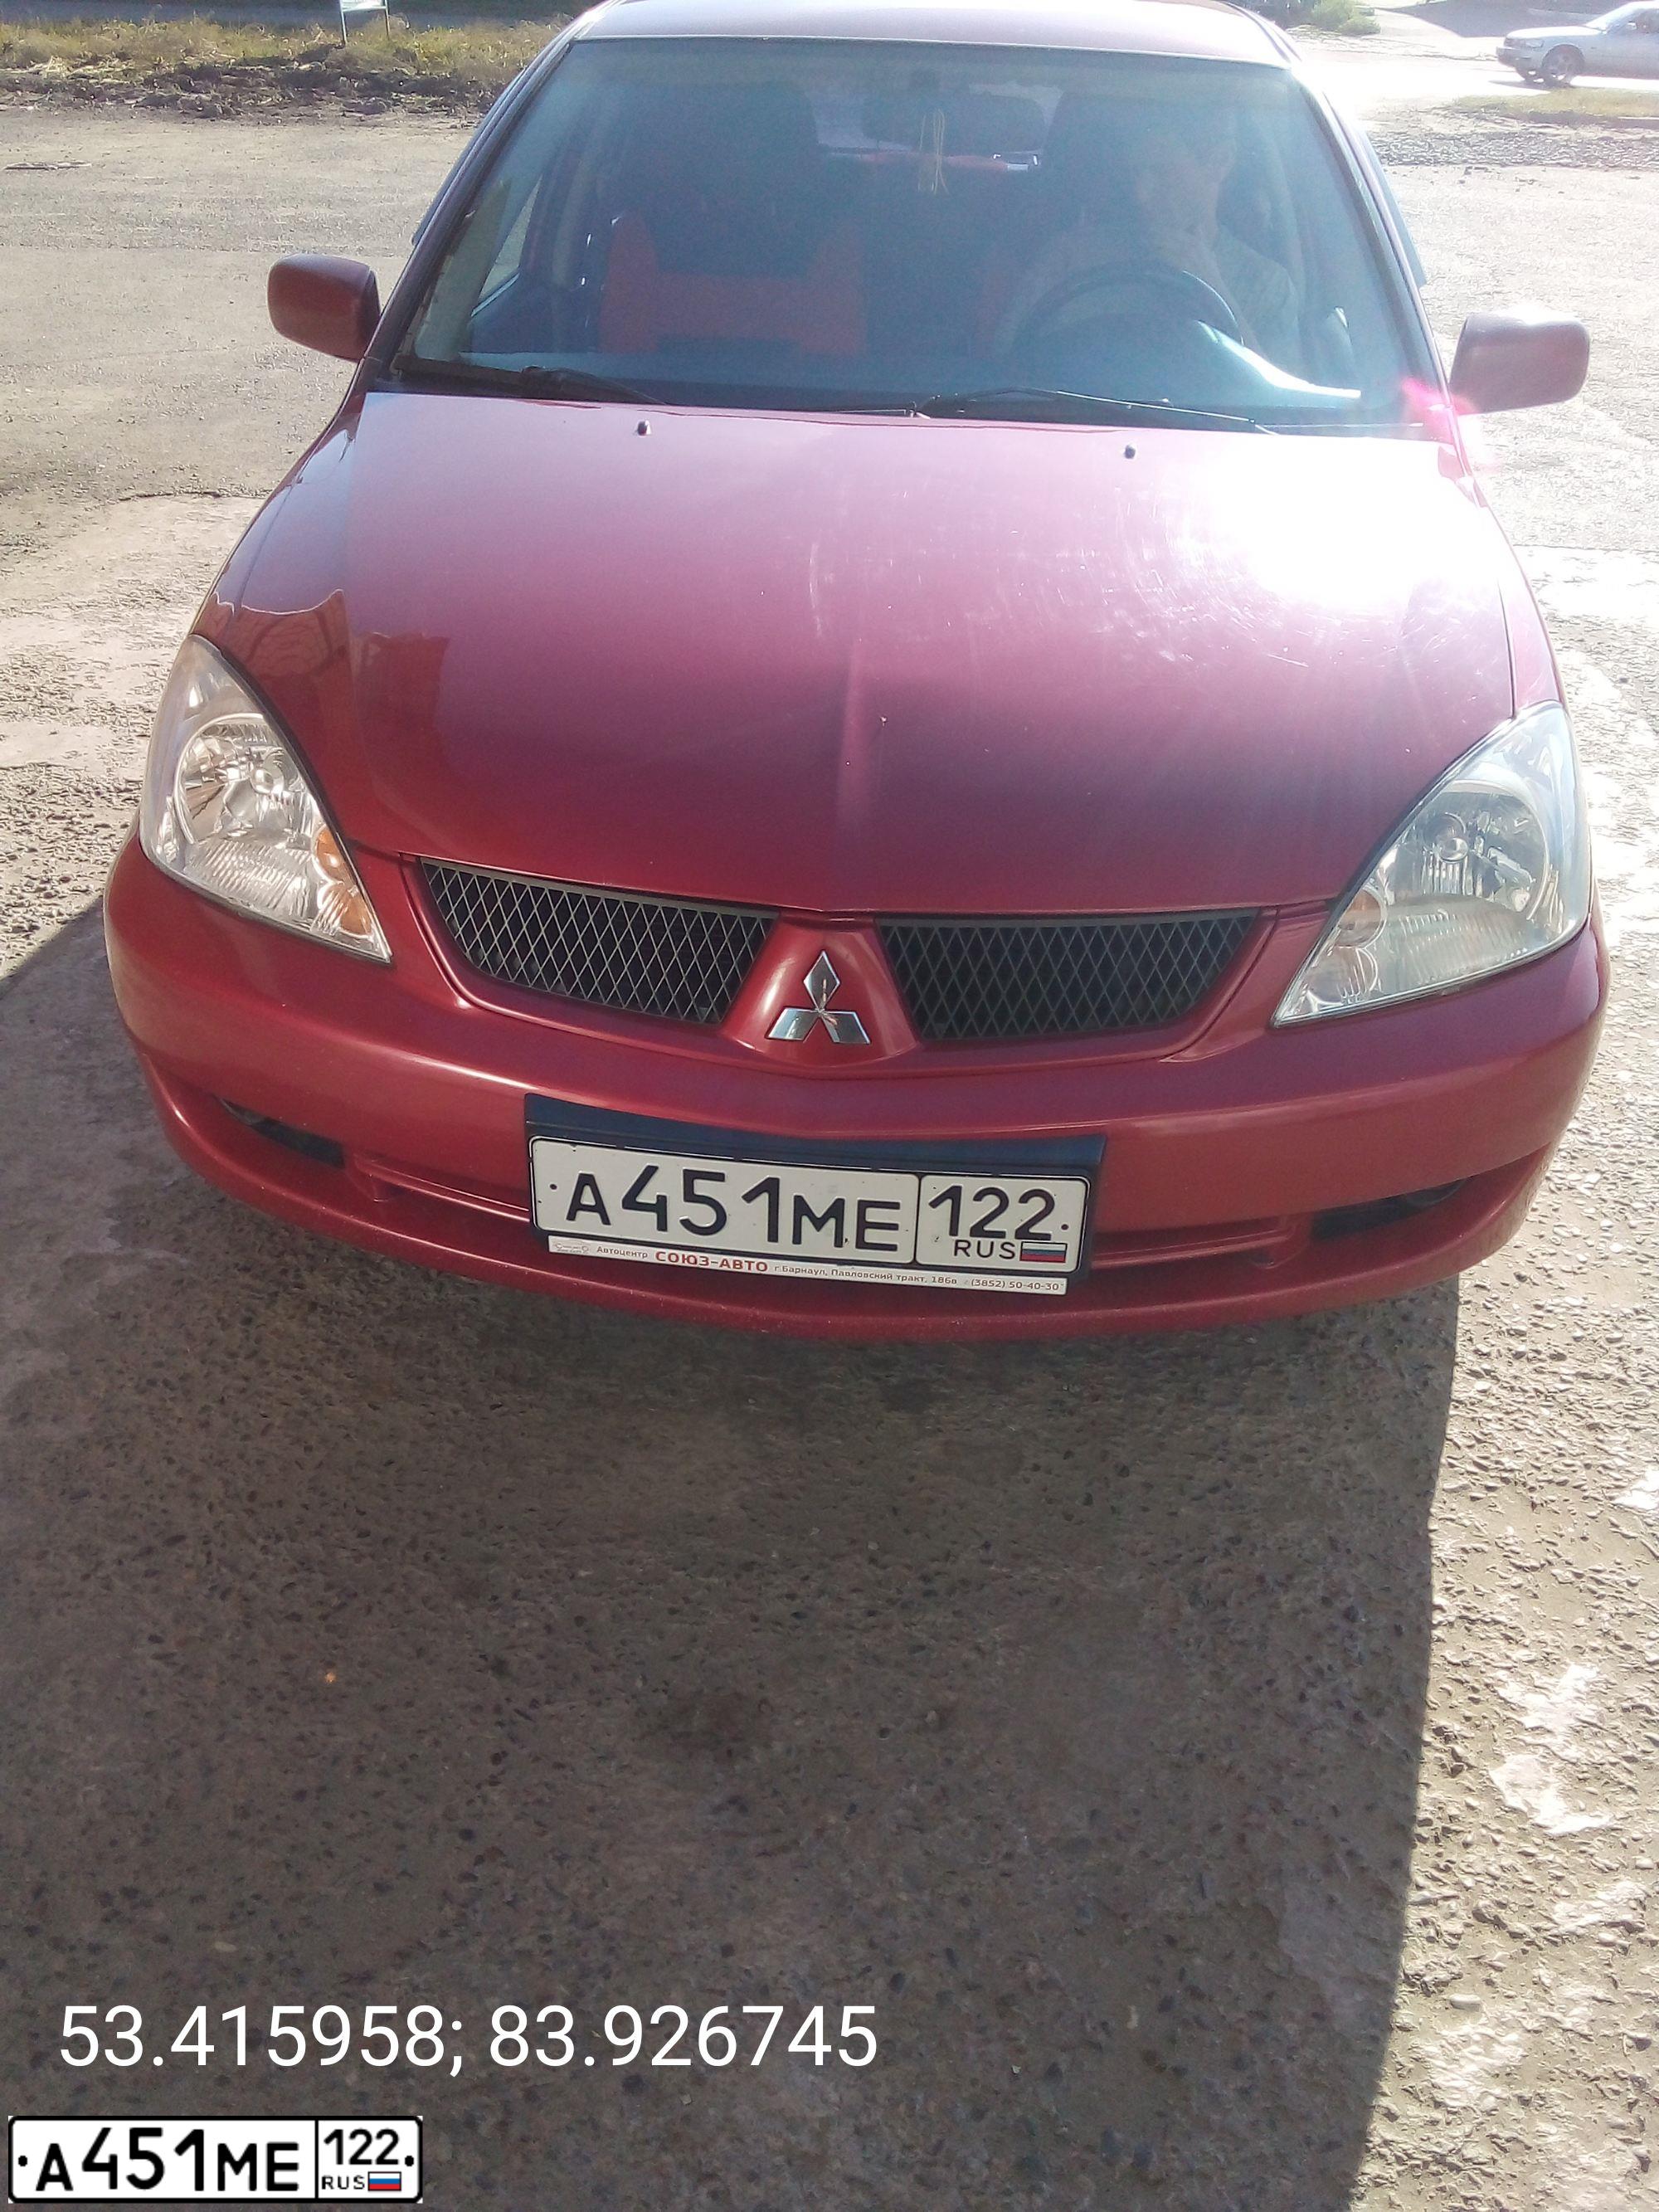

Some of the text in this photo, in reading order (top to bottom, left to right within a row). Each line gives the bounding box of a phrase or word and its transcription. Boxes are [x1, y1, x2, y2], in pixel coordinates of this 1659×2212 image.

[566, 1164, 1055, 1252] А451МЕ 122
[596, 1245, 649, 1259] Автоцентр
[655, 1250, 768, 1272] СОЮЗ-АВТО
[831, 1269, 893, 1280] Павловский
[971, 1279, 1005, 1288] (3852)
[1009, 1281, 1059, 1290] 50-40-30
[954, 1240, 1015, 1259] RUS
